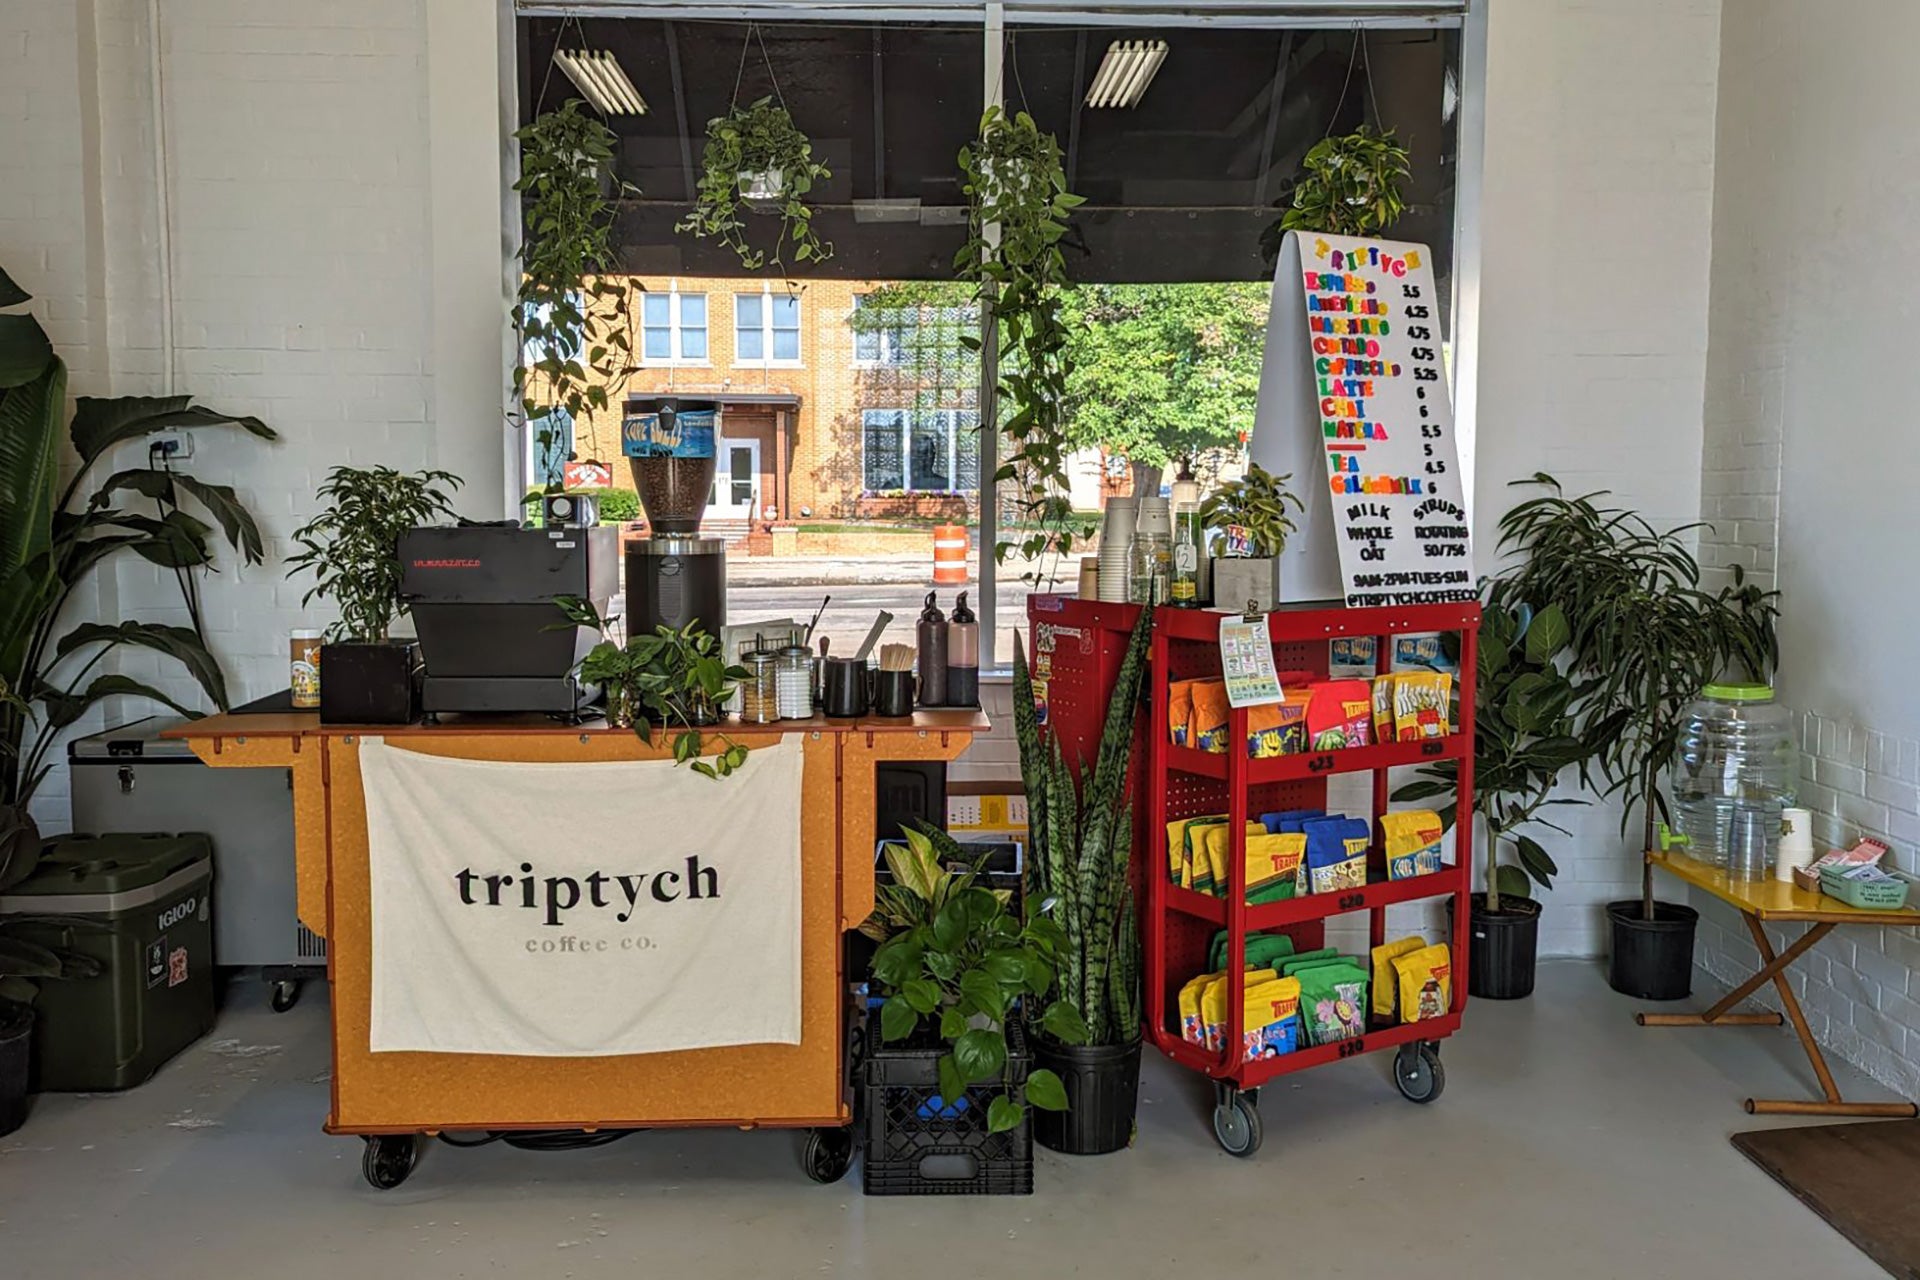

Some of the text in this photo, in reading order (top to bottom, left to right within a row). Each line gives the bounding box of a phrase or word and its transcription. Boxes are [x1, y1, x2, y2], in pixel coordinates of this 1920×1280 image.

[1319, 378, 1425, 399] LATTE 6
[1321, 397, 1428, 418] CHAI 6
[1323, 420, 1442, 440] MATCHA 5.5
[1424, 443, 1433, 456] 5
[1330, 453, 1445, 474] TEA 4.5
[1428, 481, 1437, 494] 6
[1346, 503, 1390, 521] MILK
[1413, 498, 1465, 521] SYRUPS
[1346, 526, 1393, 540] WHOLE
[1414, 526, 1469, 539] ROTATING
[1360, 547, 1385, 560] OAT
[454, 855, 721, 926] triptych
[525, 936, 657, 953] coffee co.
